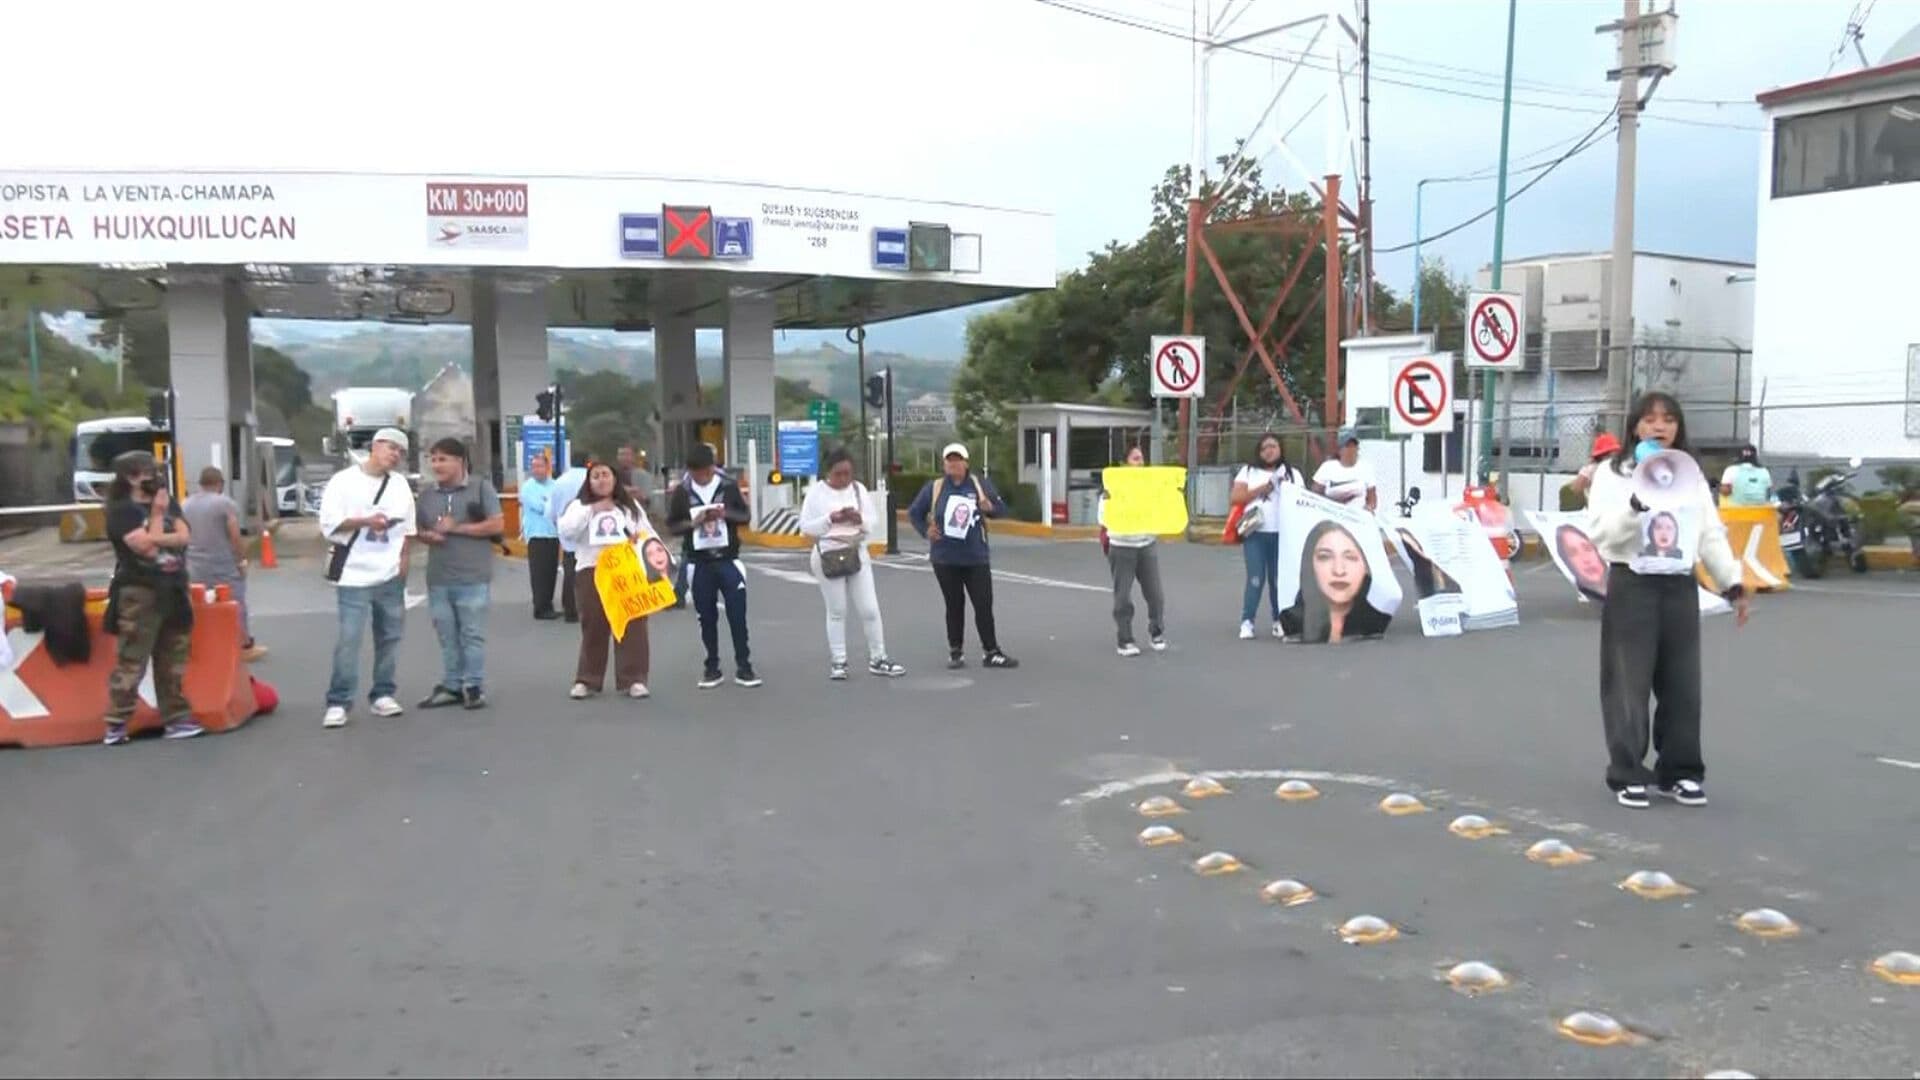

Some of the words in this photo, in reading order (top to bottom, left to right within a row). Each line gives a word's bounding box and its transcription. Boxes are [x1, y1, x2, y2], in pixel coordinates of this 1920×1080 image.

[0, 184, 69, 201] OPISTA
[83, 185, 107, 201] LA
[112, 184, 275, 201] VENTA-CHAMAPA
[429, 188, 458, 211] KM
[463, 189, 525, 212] 30+000
[0, 215, 73, 240] SETA
[93, 214, 296, 241] HUIXQUILUCAN
